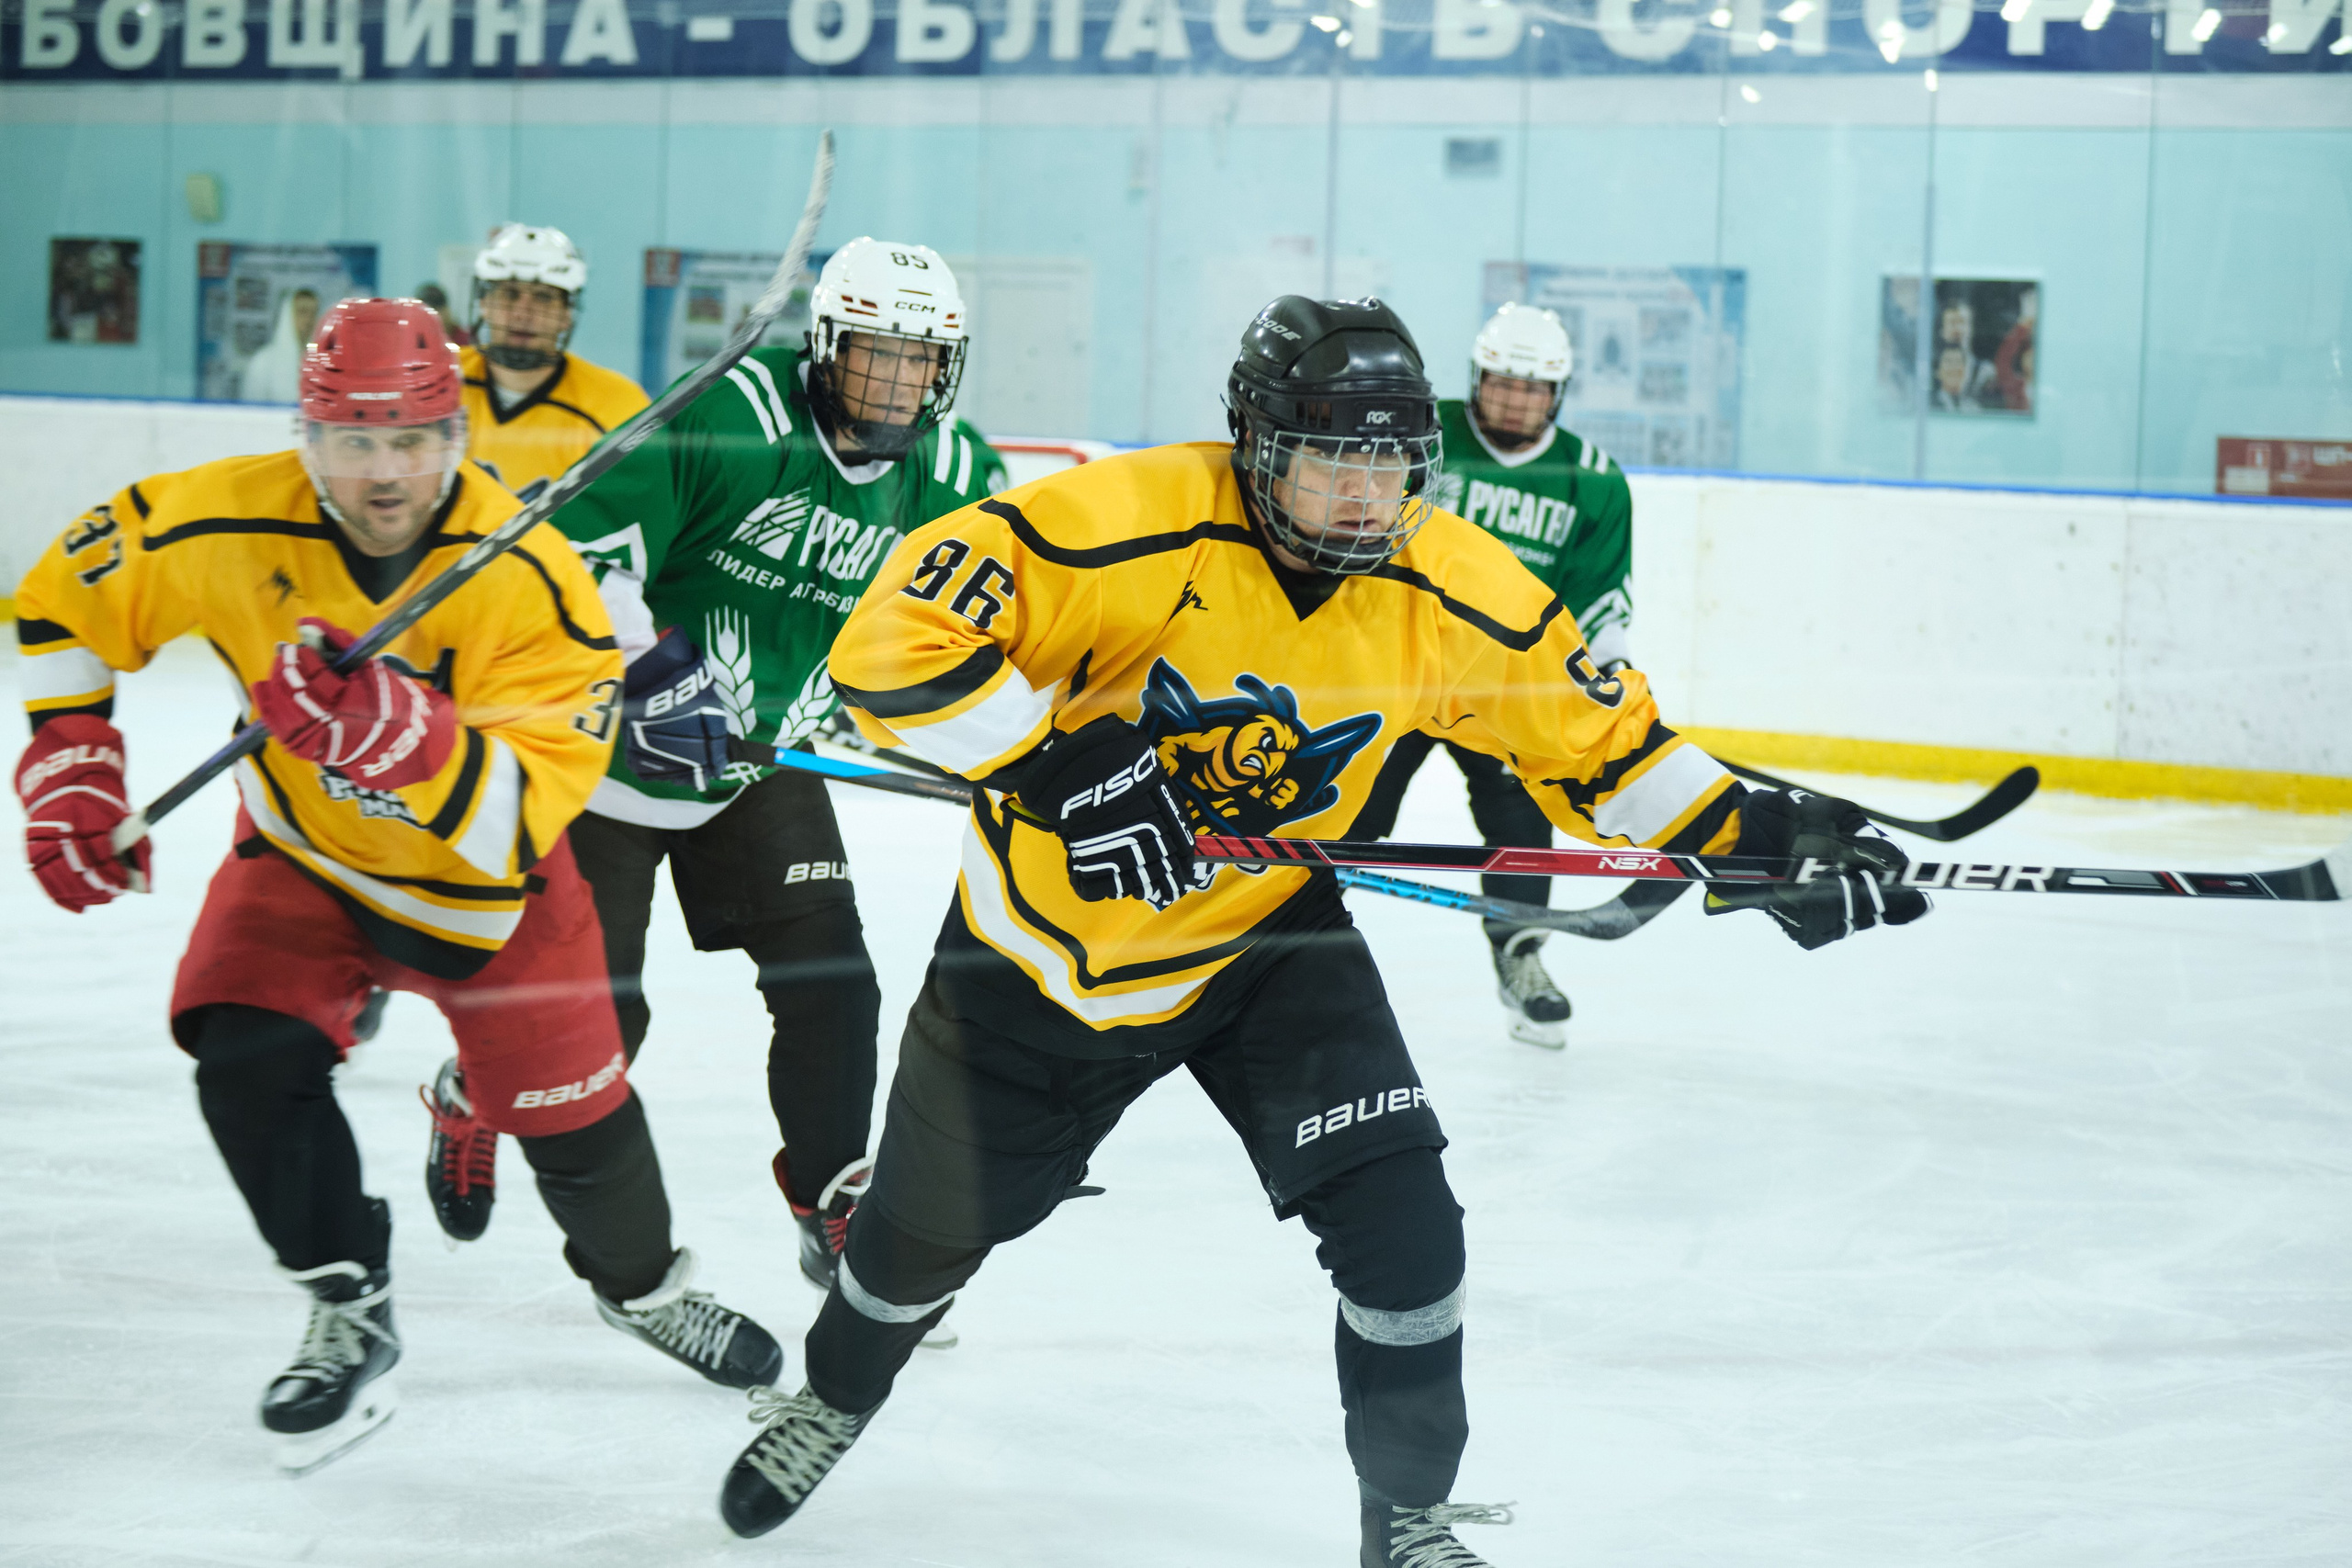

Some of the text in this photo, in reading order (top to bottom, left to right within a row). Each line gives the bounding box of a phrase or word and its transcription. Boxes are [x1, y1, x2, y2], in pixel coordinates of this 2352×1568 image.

[890, 252, 929, 270] 85
[894, 299, 936, 313] CCM
[706, 548, 786, 591] ЛИДЕР
[897, 537, 1016, 630] 86
[1598, 856, 1662, 872] NSX
